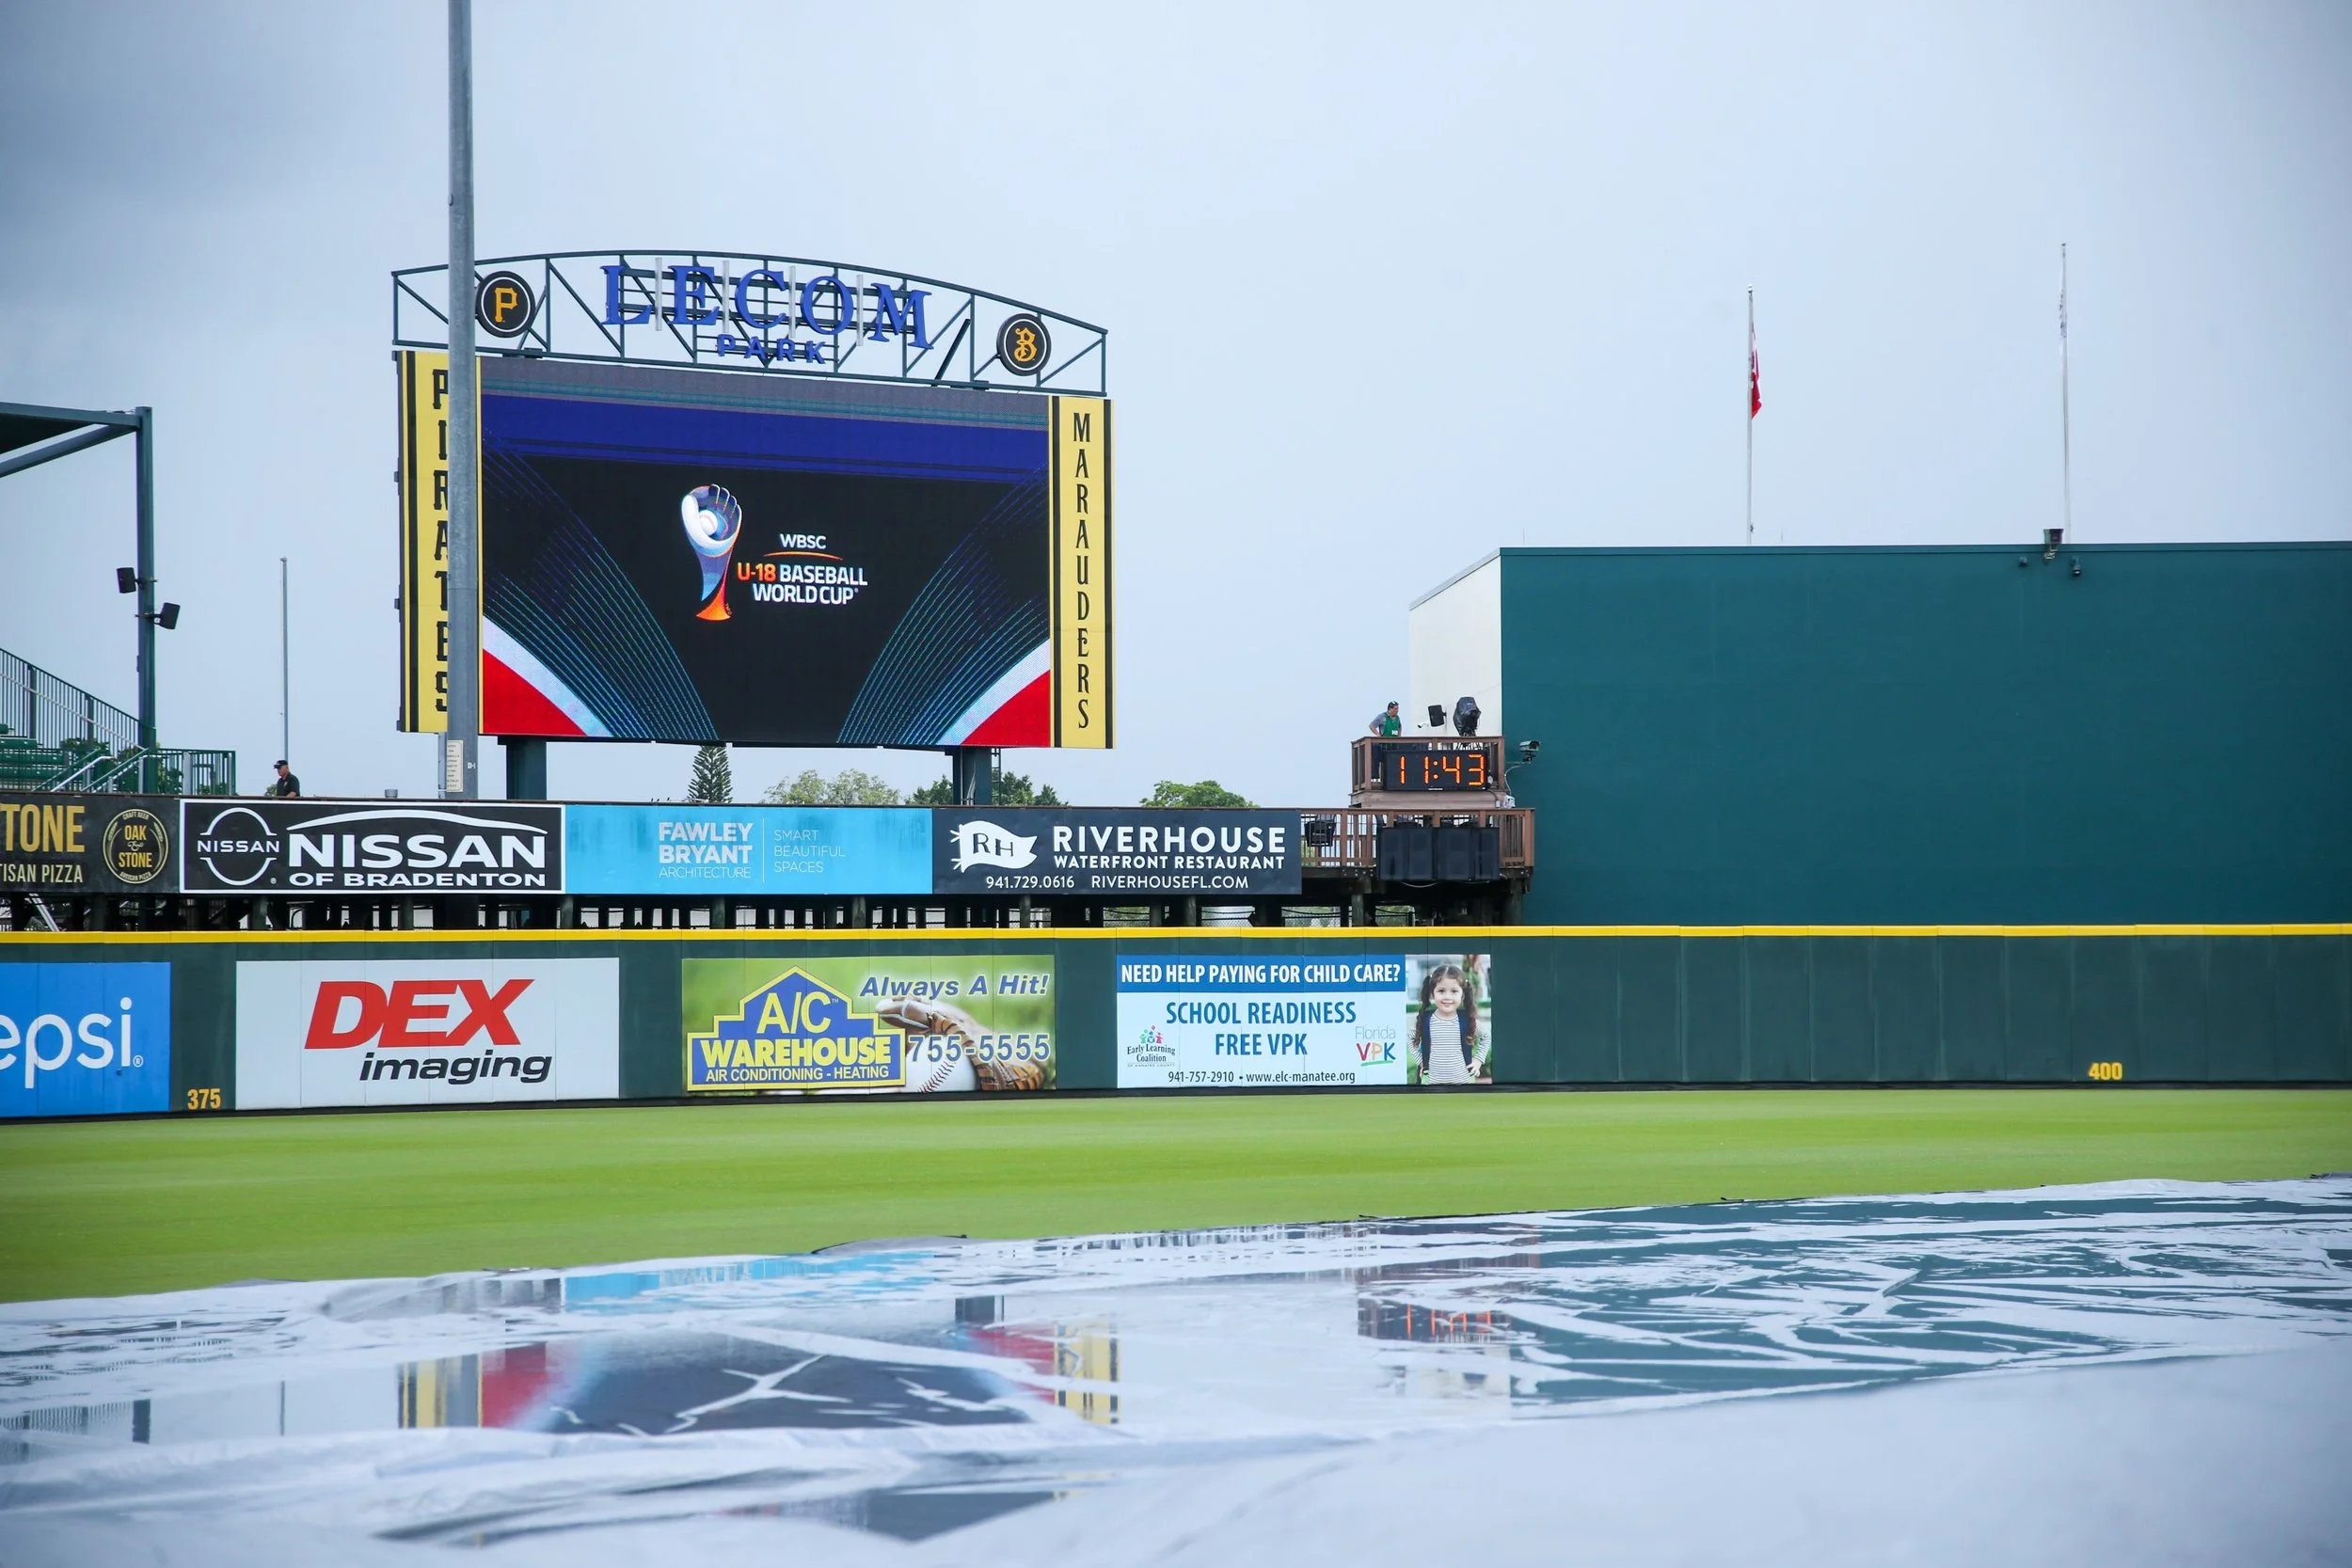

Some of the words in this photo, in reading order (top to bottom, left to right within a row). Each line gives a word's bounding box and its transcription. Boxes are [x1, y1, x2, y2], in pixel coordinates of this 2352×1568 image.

[495, 287, 518, 323] P
[599, 264, 935, 350] LECOM
[715, 333, 828, 365] PARK
[780, 533, 827, 550] WBSC
[737, 562, 777, 582] U-18
[779, 564, 868, 586] BASEBALL
[1073, 412, 1090, 730] MARAUDERS
[753, 583, 818, 604] WORLD
[819, 587, 855, 606] CUP
[1399, 753, 1486, 786] 11:43
[124, 824, 148, 841] OAK
[659, 822, 754, 842] FAWLEY
[774, 829, 819, 842] SMART
[1053, 825, 1286, 853] RIVERHOUSE
[197, 839, 280, 854] NISSAN
[288, 833, 547, 869] NISSAN
[660, 845, 753, 863] BRYANT
[774, 845, 846, 858] BEAUTIFUL
[973, 832, 1014, 857] RH
[119, 851, 152, 868] STONE
[774, 861, 824, 873] SPACES
[1054, 855, 1168, 869] WATERFRONT
[1174, 856, 1285, 869] RESTAURANT
[0, 863, 37, 883] ISAN
[41, 864, 84, 884] PIZZA
[289, 873, 335, 887] OF
[343, 873, 547, 888] BRADENTON
[659, 866, 752, 879] ARCHITECTURE
[986, 876, 1075, 889] 941.729.0616
[1091, 876, 1249, 889] RIVERHOUSEFL.COM
[1120, 965, 1162, 984] NEED
[1166, 965, 1205, 983] HELP
[1208, 965, 1266, 984] PAYING
[1269, 964, 1300, 983] FOR
[1304, 964, 1351, 983] CHILD
[1354, 963, 1401, 982] CARE?
[860, 975, 960, 1001] Always
[968, 974, 989, 995] A
[998, 974, 1050, 995] Hit!
[304, 979, 535, 1049] DEX
[755, 991, 833, 1035] A/C
[1166, 1002, 1242, 1025] SCHOOL
[1248, 1001, 1357, 1024] READINESS
[1355, 1026, 1396, 1040] Florida
[700, 1037, 892, 1068] WAREHOUSE
[907, 1033, 1052, 1063] 755-5555
[1127, 1044, 1144, 1055] Early
[1146, 1043, 1176, 1056] Learning
[1216, 1034, 1263, 1055] FREE
[1266, 1033, 1308, 1055] VPK
[1356, 1043, 1397, 1062] VPK
[359, 1049, 552, 1085] imaging
[1136, 1053, 1167, 1062] Coalition
[706, 1069, 729, 1083] AIR
[731, 1068, 823, 1081] CONDITIONING
[834, 1066, 889, 1080] HEATING
[1168, 1070, 1234, 1083] 941-757-2910
[1246, 1070, 1356, 1085] www.elc-manatee.org
[2089, 1062, 2123, 1081] 400
[187, 1088, 222, 1110] 375
